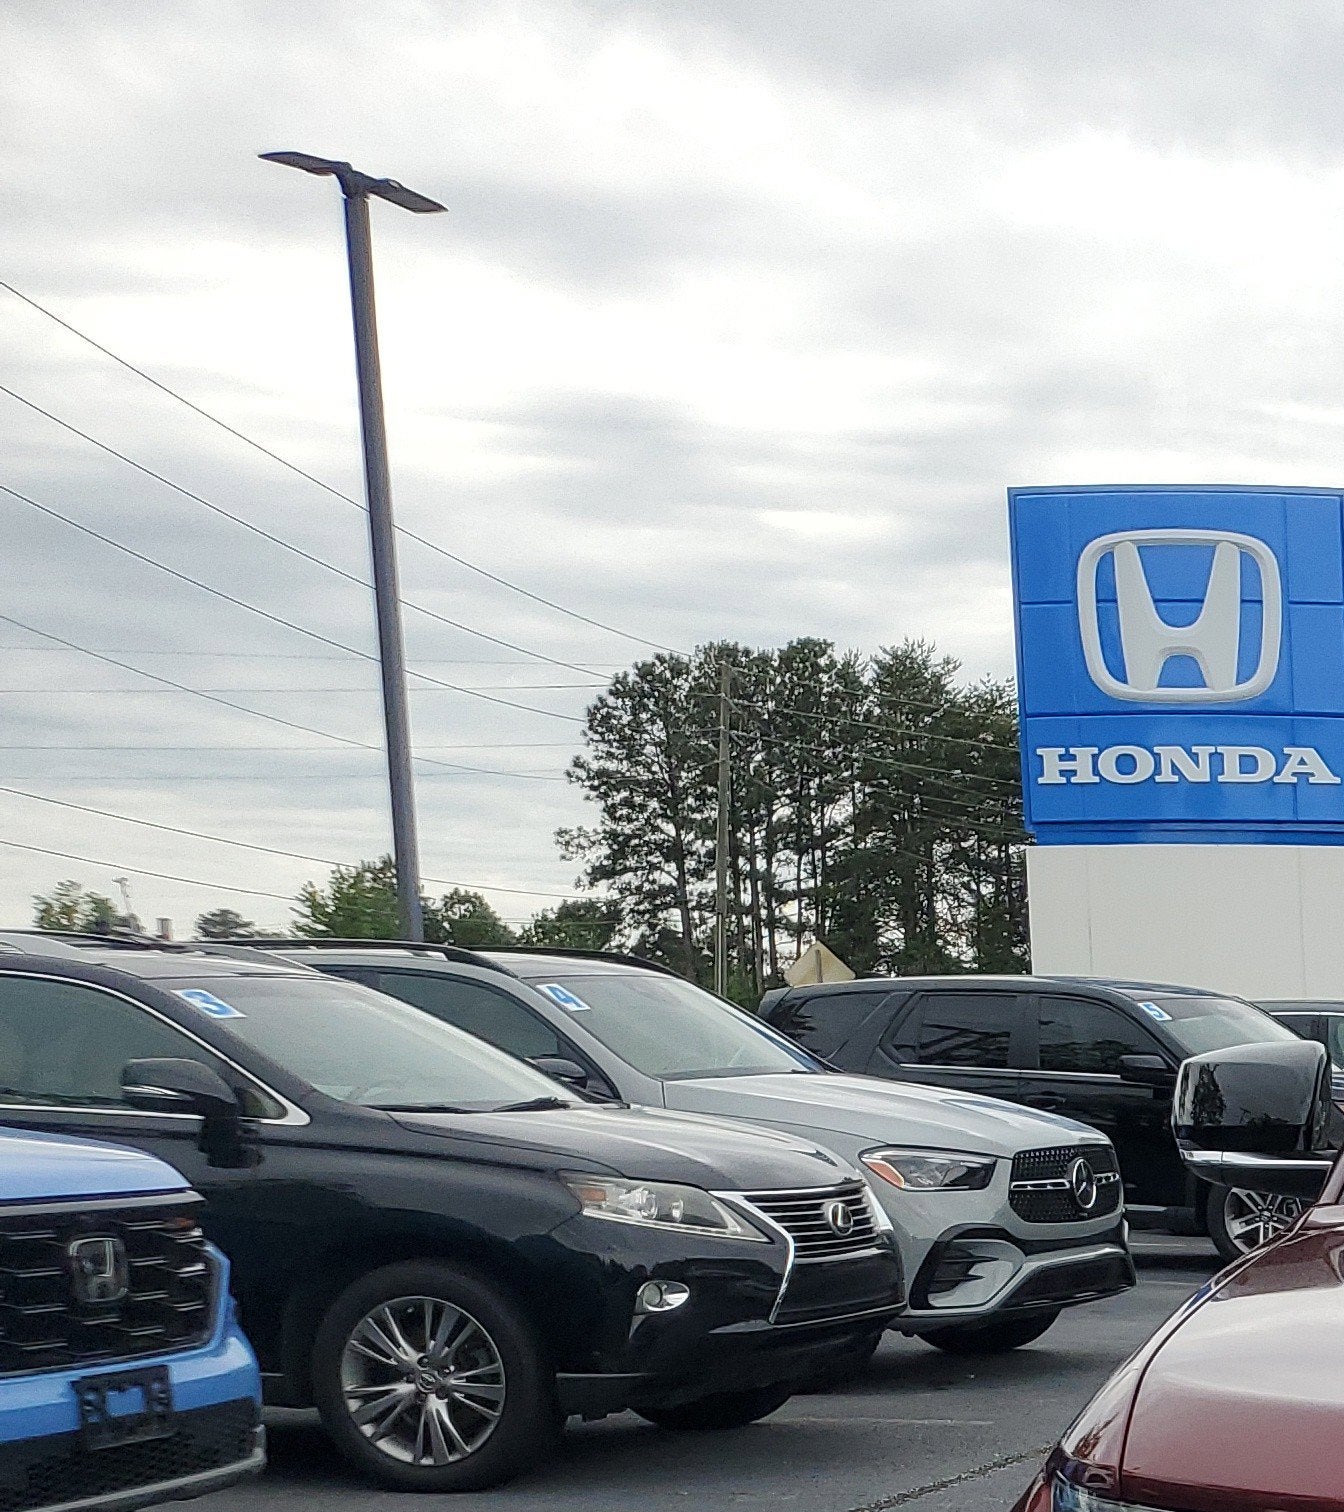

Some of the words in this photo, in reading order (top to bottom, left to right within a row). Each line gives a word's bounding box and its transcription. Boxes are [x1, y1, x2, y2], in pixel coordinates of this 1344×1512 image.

[1036, 745, 1342, 785] HONDA
[182, 991, 232, 1016] 3
[545, 985, 586, 1008] 4
